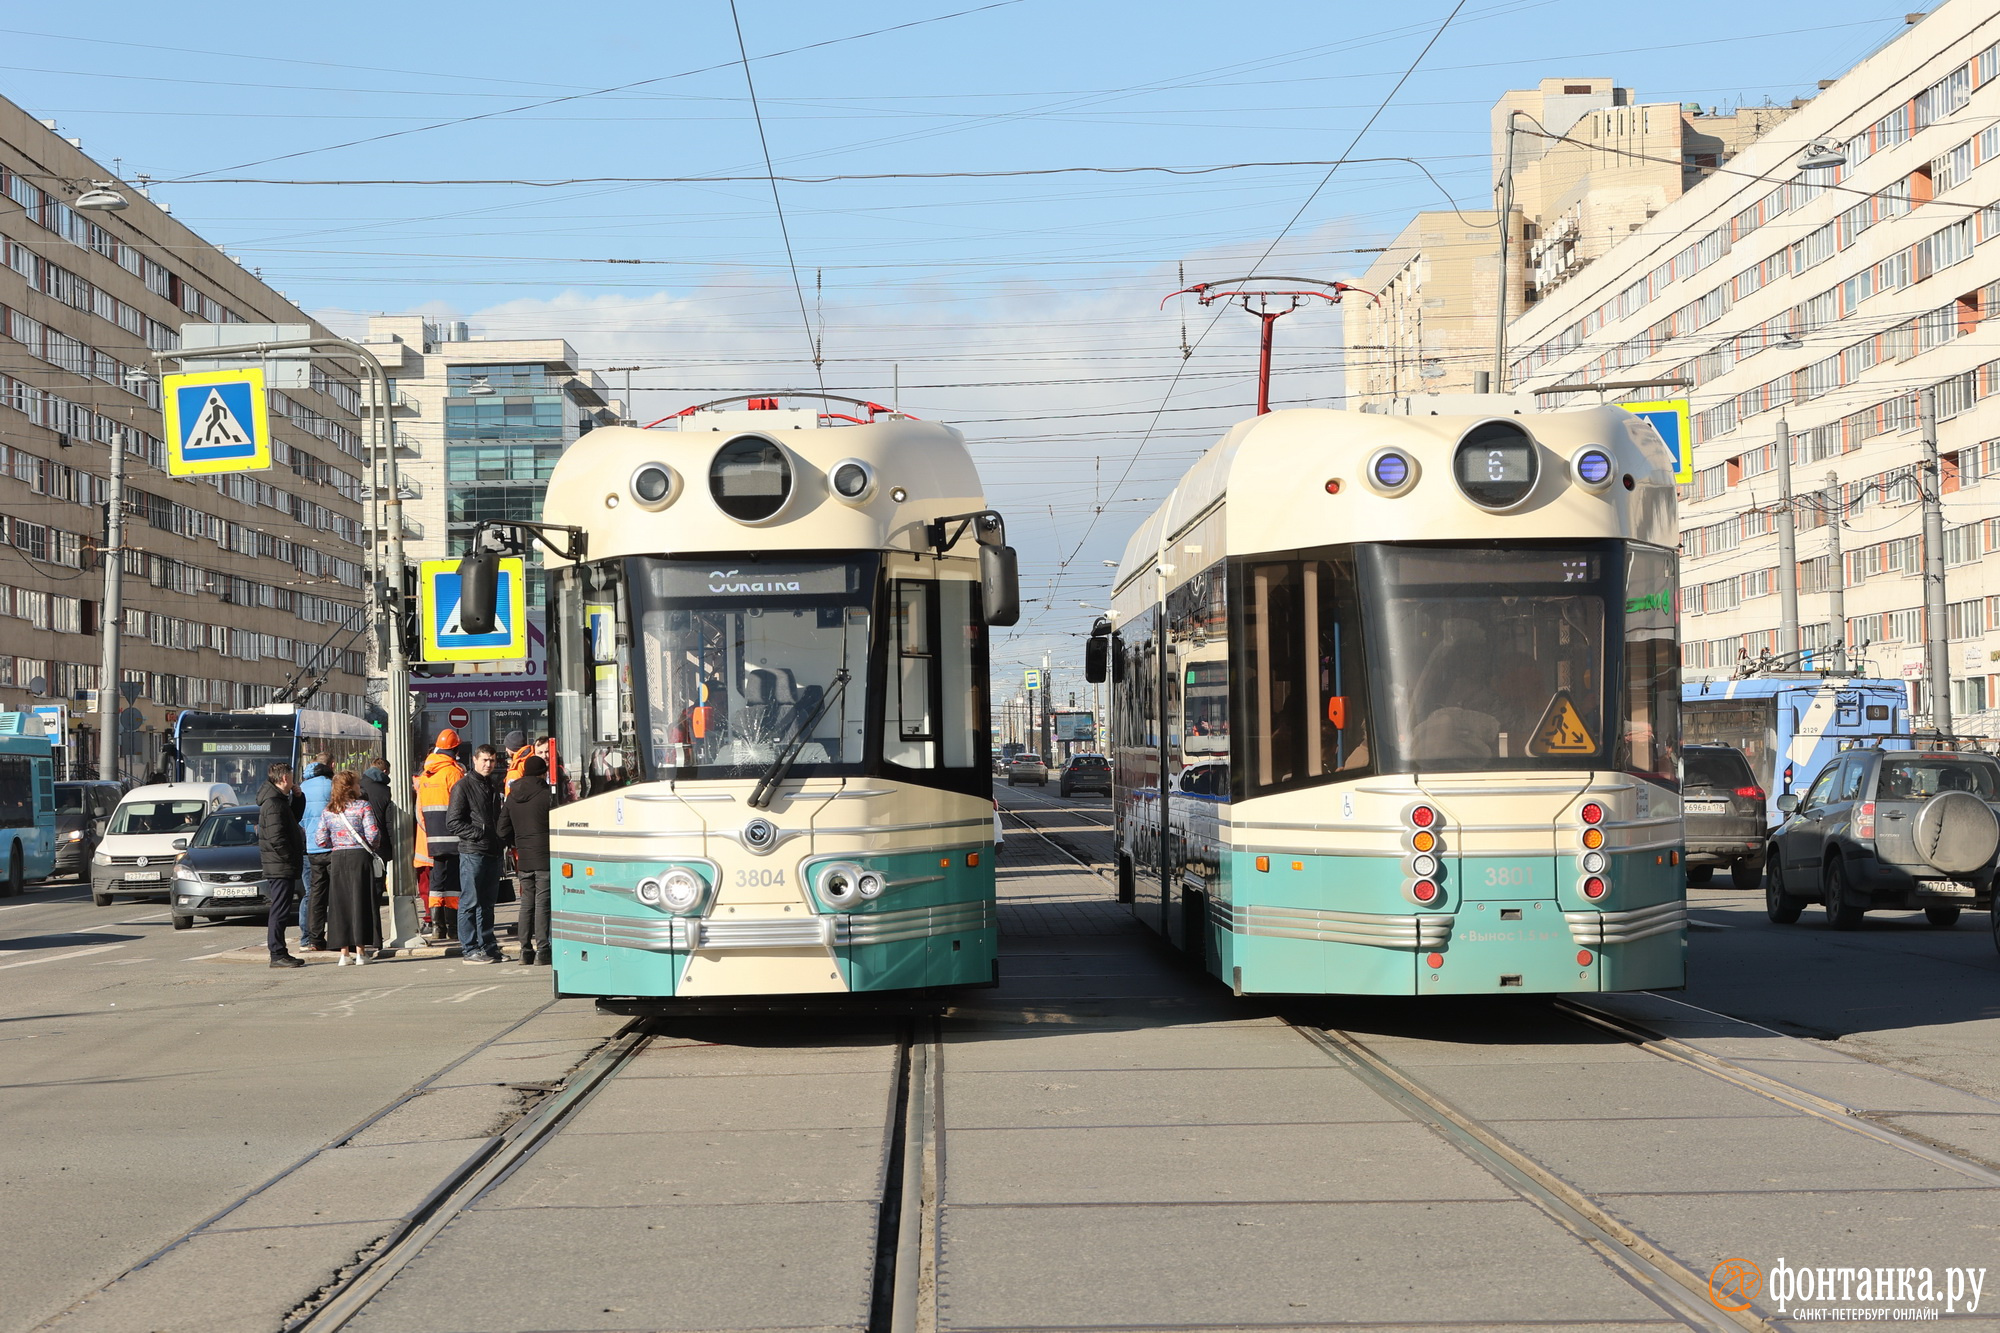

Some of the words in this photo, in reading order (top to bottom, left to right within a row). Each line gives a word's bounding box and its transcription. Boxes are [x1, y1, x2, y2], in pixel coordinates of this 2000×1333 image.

[1488, 450, 1504, 481] 6
[440, 691, 456, 700] ул.,
[457, 691, 476, 700] дом
[477, 689, 492, 699] 44,
[493, 690, 524, 700] корпус
[526, 688, 535, 698] 1,
[536, 688, 542, 696] 1
[1874, 707, 1880, 718] 9
[205, 743, 212, 751] 10
[216, 743, 233, 751] елей
[248, 743, 271, 752] Новгор
[735, 869, 785, 887] 3804
[1484, 867, 1534, 886] 3801
[1469, 930, 1516, 942] Вынос
[1538, 933, 1549, 941] м
